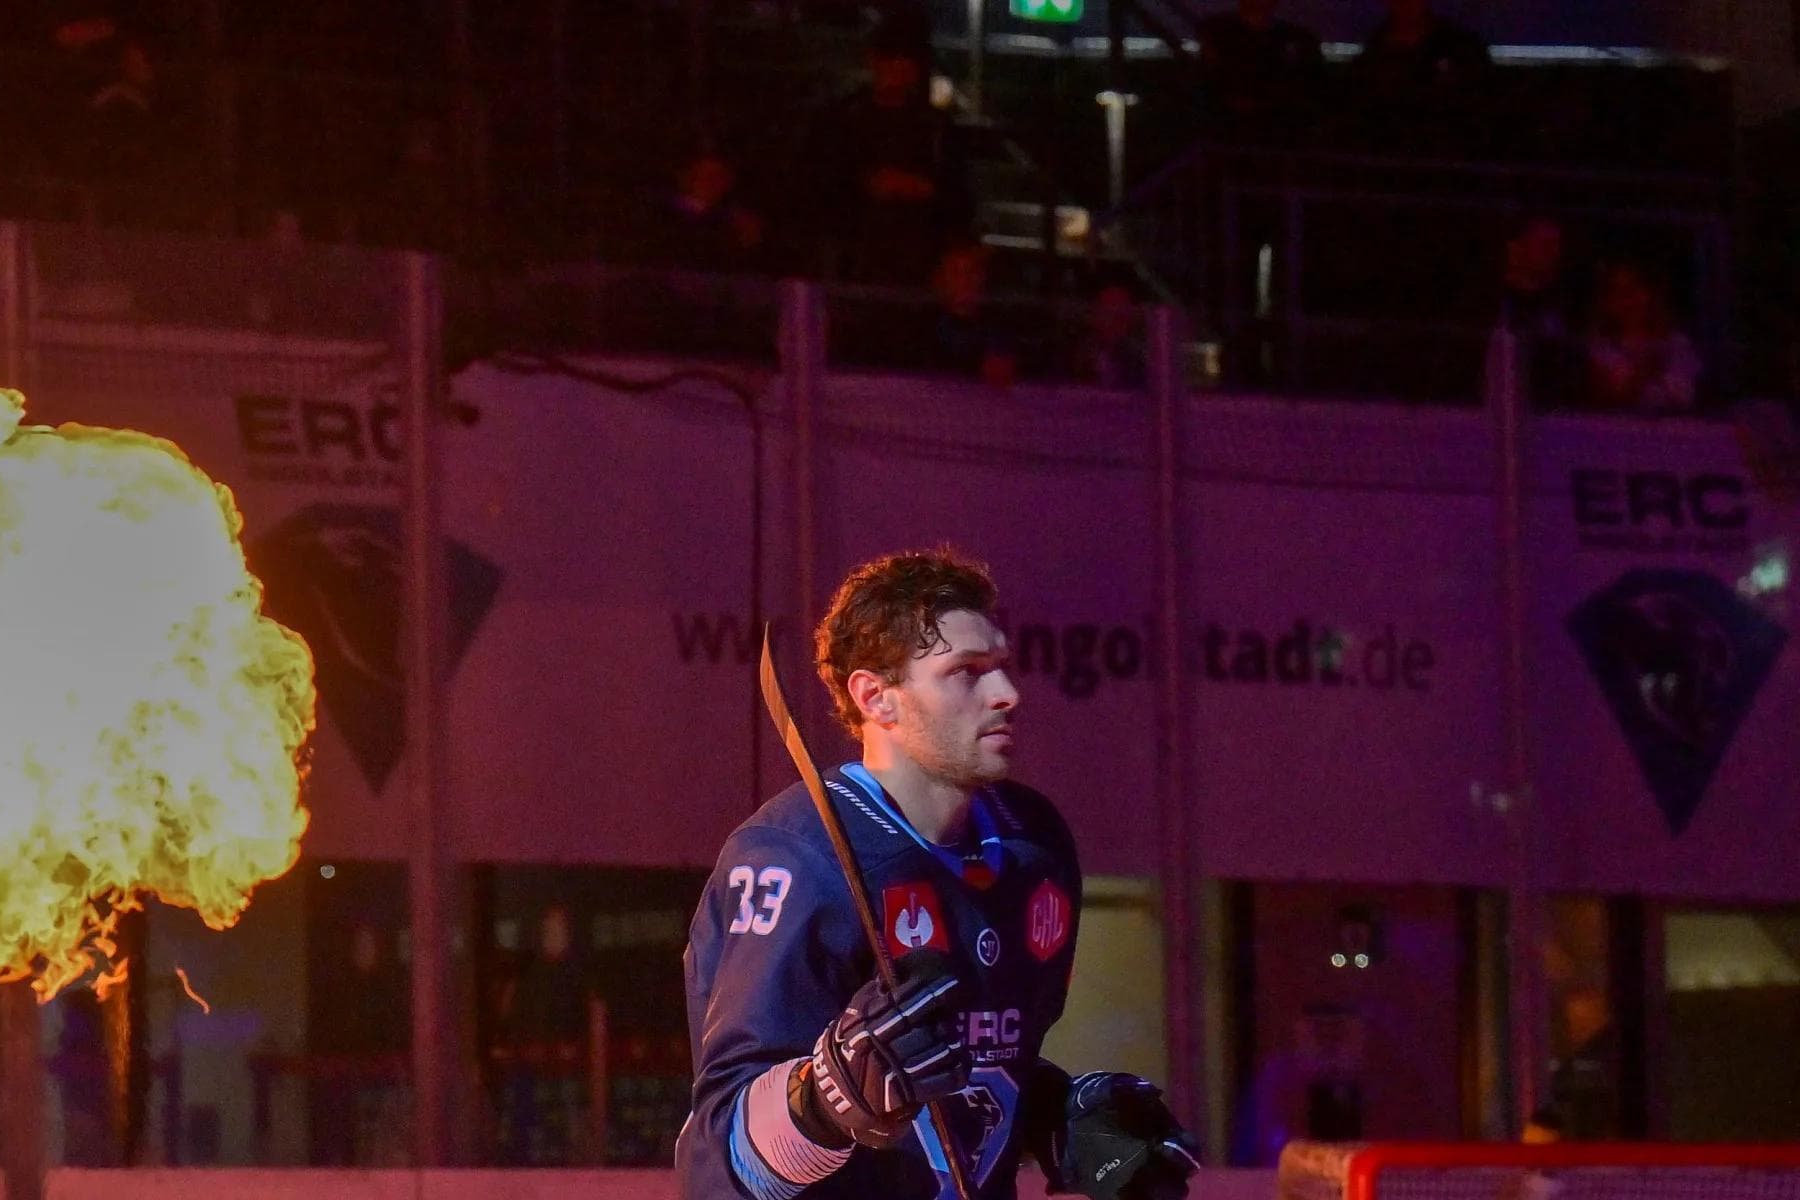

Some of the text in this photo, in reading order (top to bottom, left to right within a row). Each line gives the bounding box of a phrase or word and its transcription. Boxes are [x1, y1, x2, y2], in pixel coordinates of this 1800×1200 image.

[1571, 468, 1749, 529] ERC
[728, 864, 793, 936] 33
[1032, 891, 1064, 950] CHL
[955, 1008, 1021, 1046] RC
